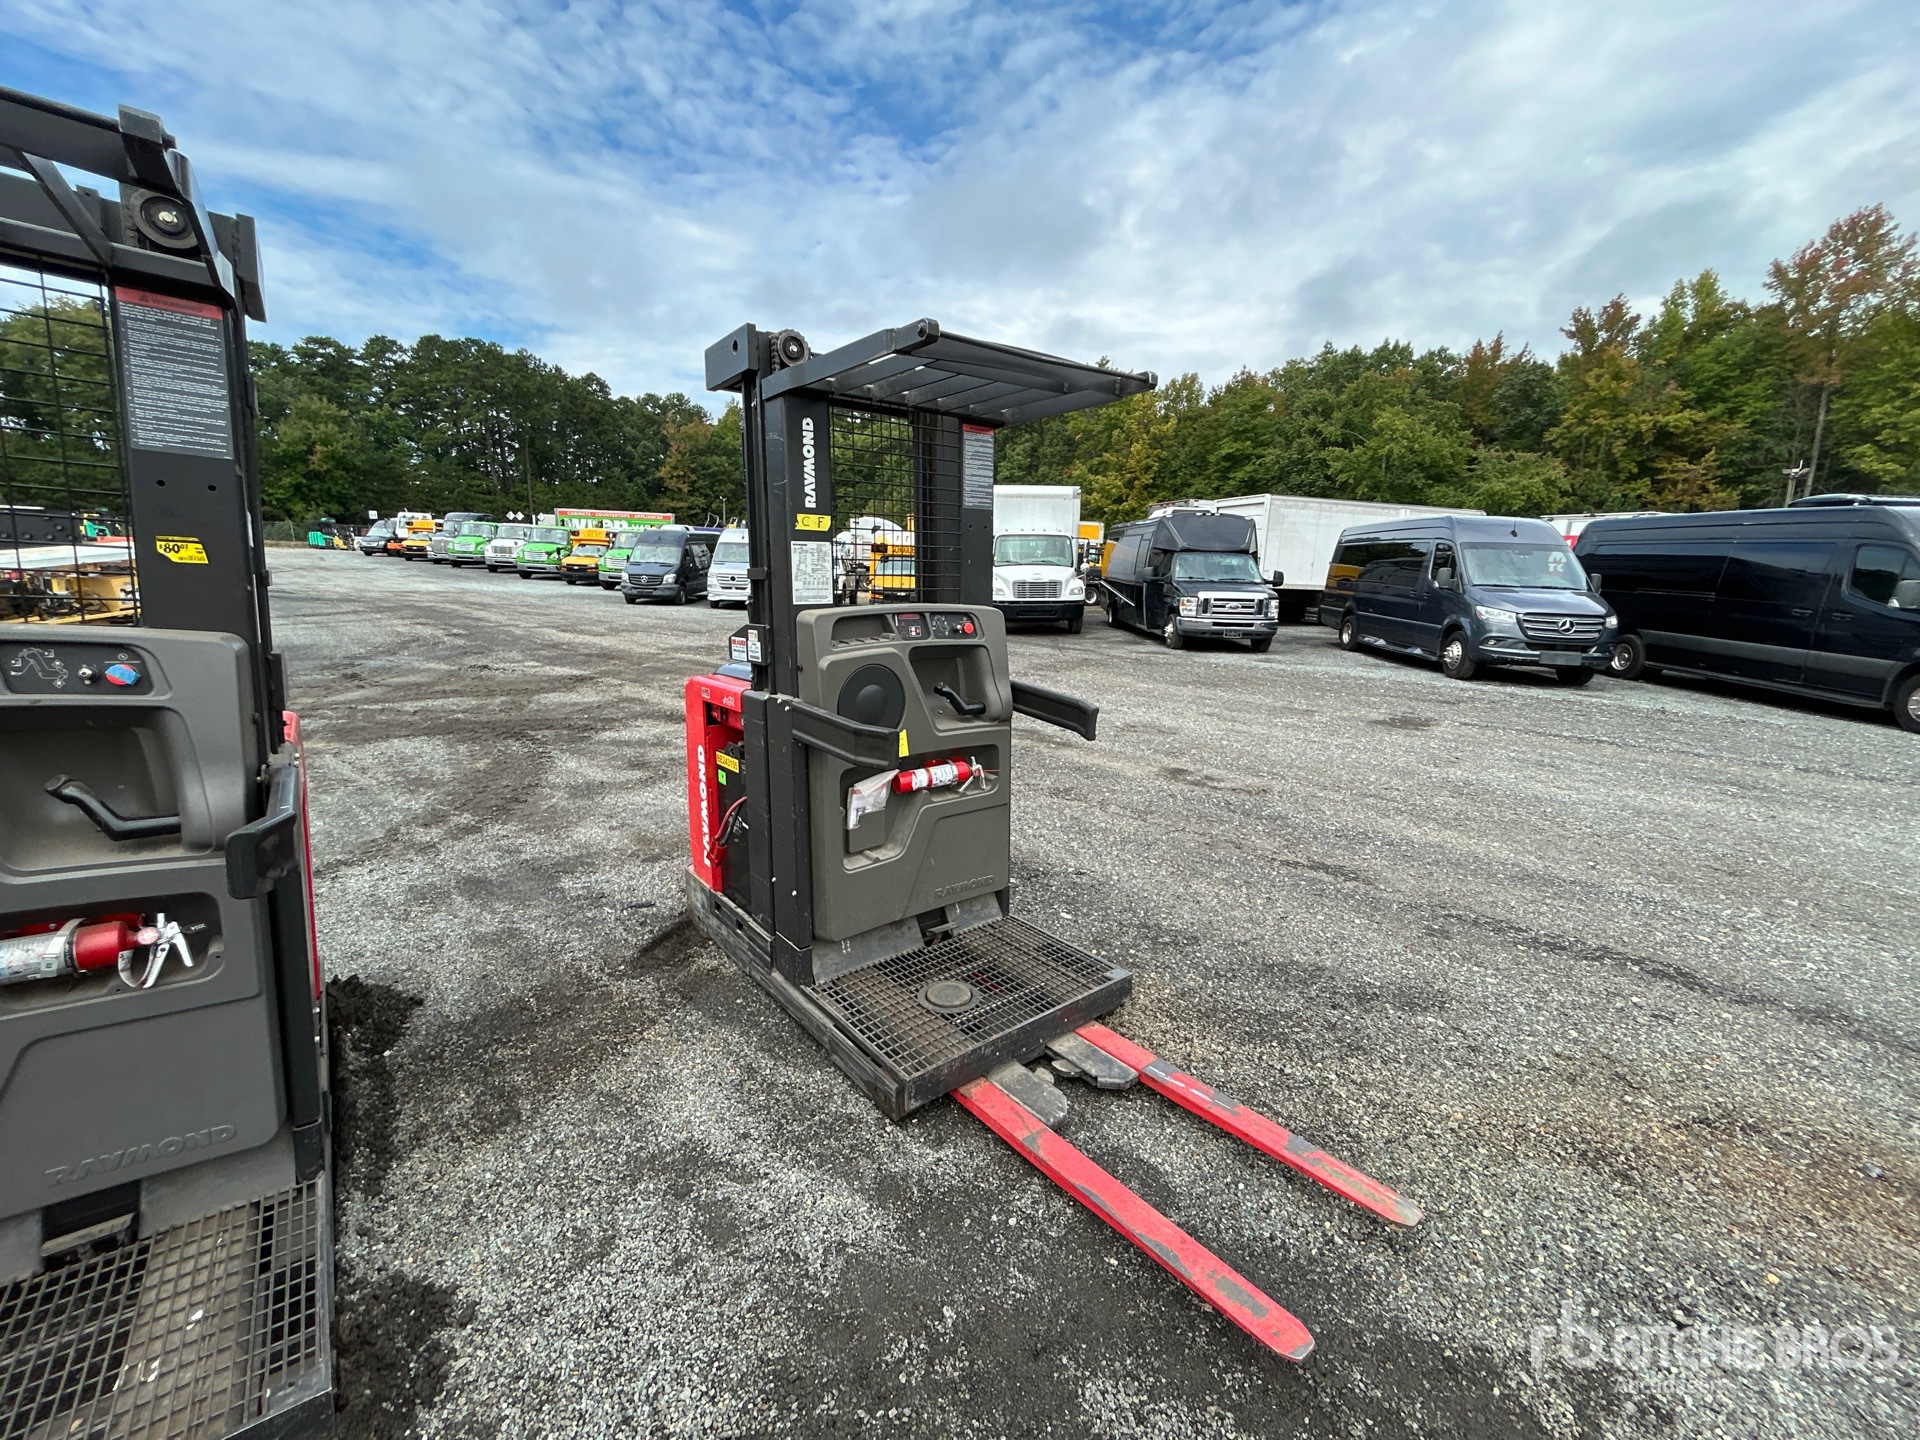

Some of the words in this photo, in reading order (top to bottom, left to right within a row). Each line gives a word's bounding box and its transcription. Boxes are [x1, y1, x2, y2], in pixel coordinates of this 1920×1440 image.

[802, 417, 817, 508] RAYMOND
[935, 875, 994, 899] RAYMOND
[45, 1125, 237, 1185] RAYMOND
